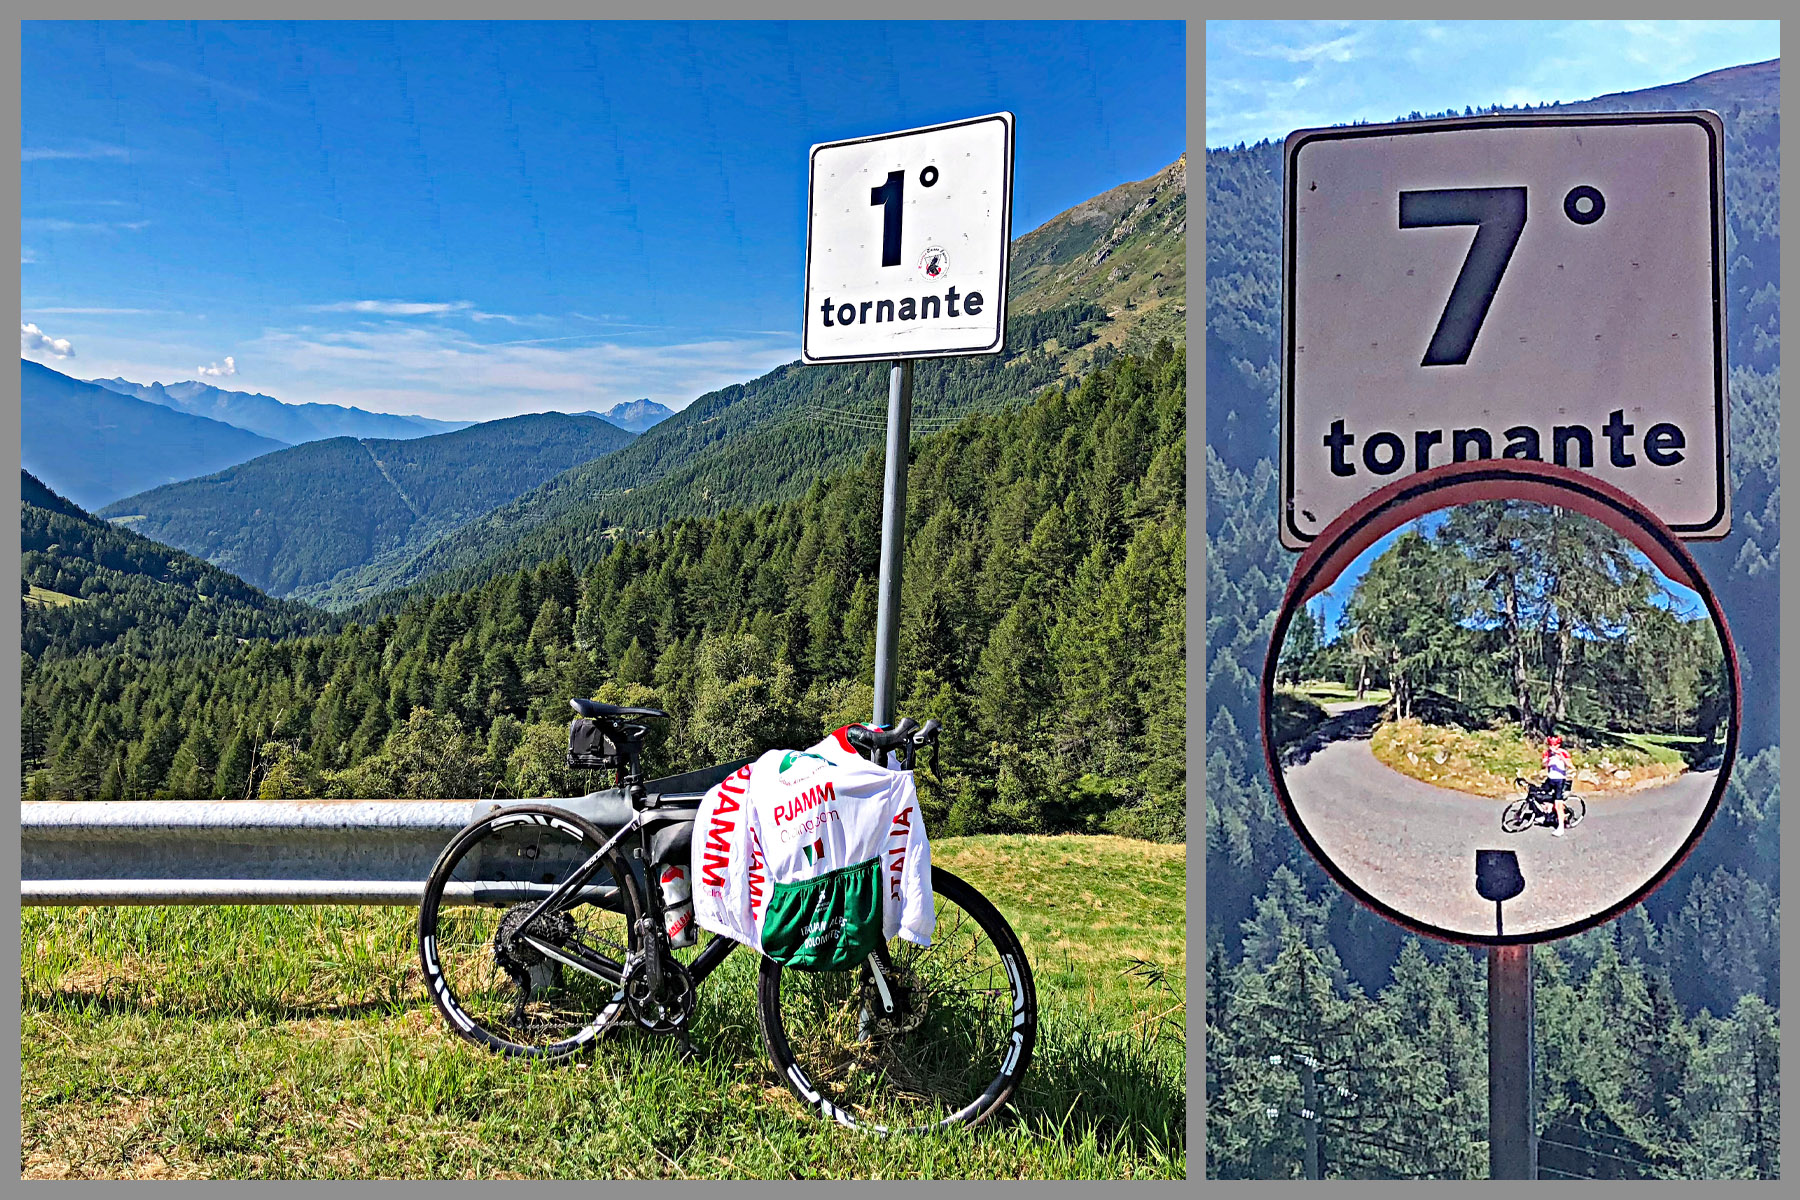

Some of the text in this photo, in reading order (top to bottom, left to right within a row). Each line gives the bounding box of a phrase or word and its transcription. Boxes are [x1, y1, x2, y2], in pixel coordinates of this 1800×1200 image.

[870, 165, 939, 267] 1°
[821, 285, 984, 328] tornante
[1399, 185, 1606, 367] 7°
[1323, 409, 1686, 477] tornante
[773, 781, 836, 826] PJAMM
